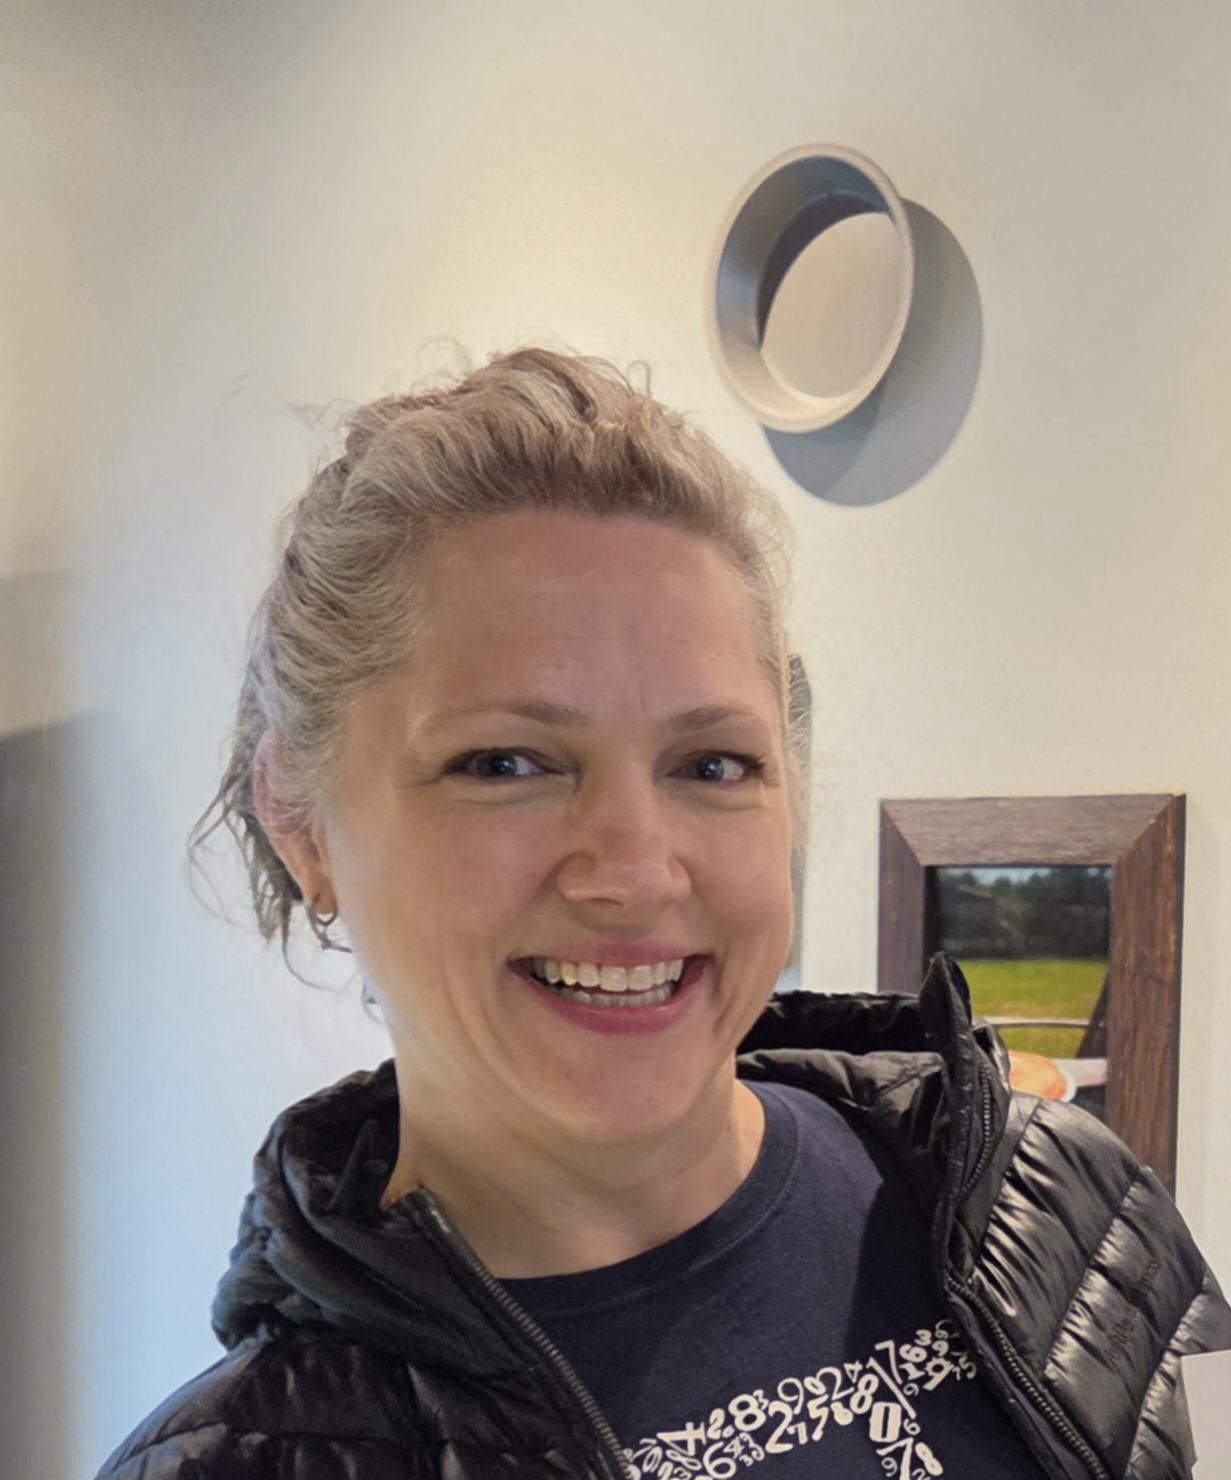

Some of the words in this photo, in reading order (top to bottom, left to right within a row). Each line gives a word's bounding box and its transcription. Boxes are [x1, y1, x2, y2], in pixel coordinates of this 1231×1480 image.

[777, 1377, 804, 1415] 9
[817, 1366, 855, 1401] 2
[850, 1373, 880, 1415] 8
[728, 1394, 767, 1432] 8
[765, 1400, 794, 1454] 2
[868, 1401, 902, 1443] 0
[703, 1441, 737, 1480] 6
